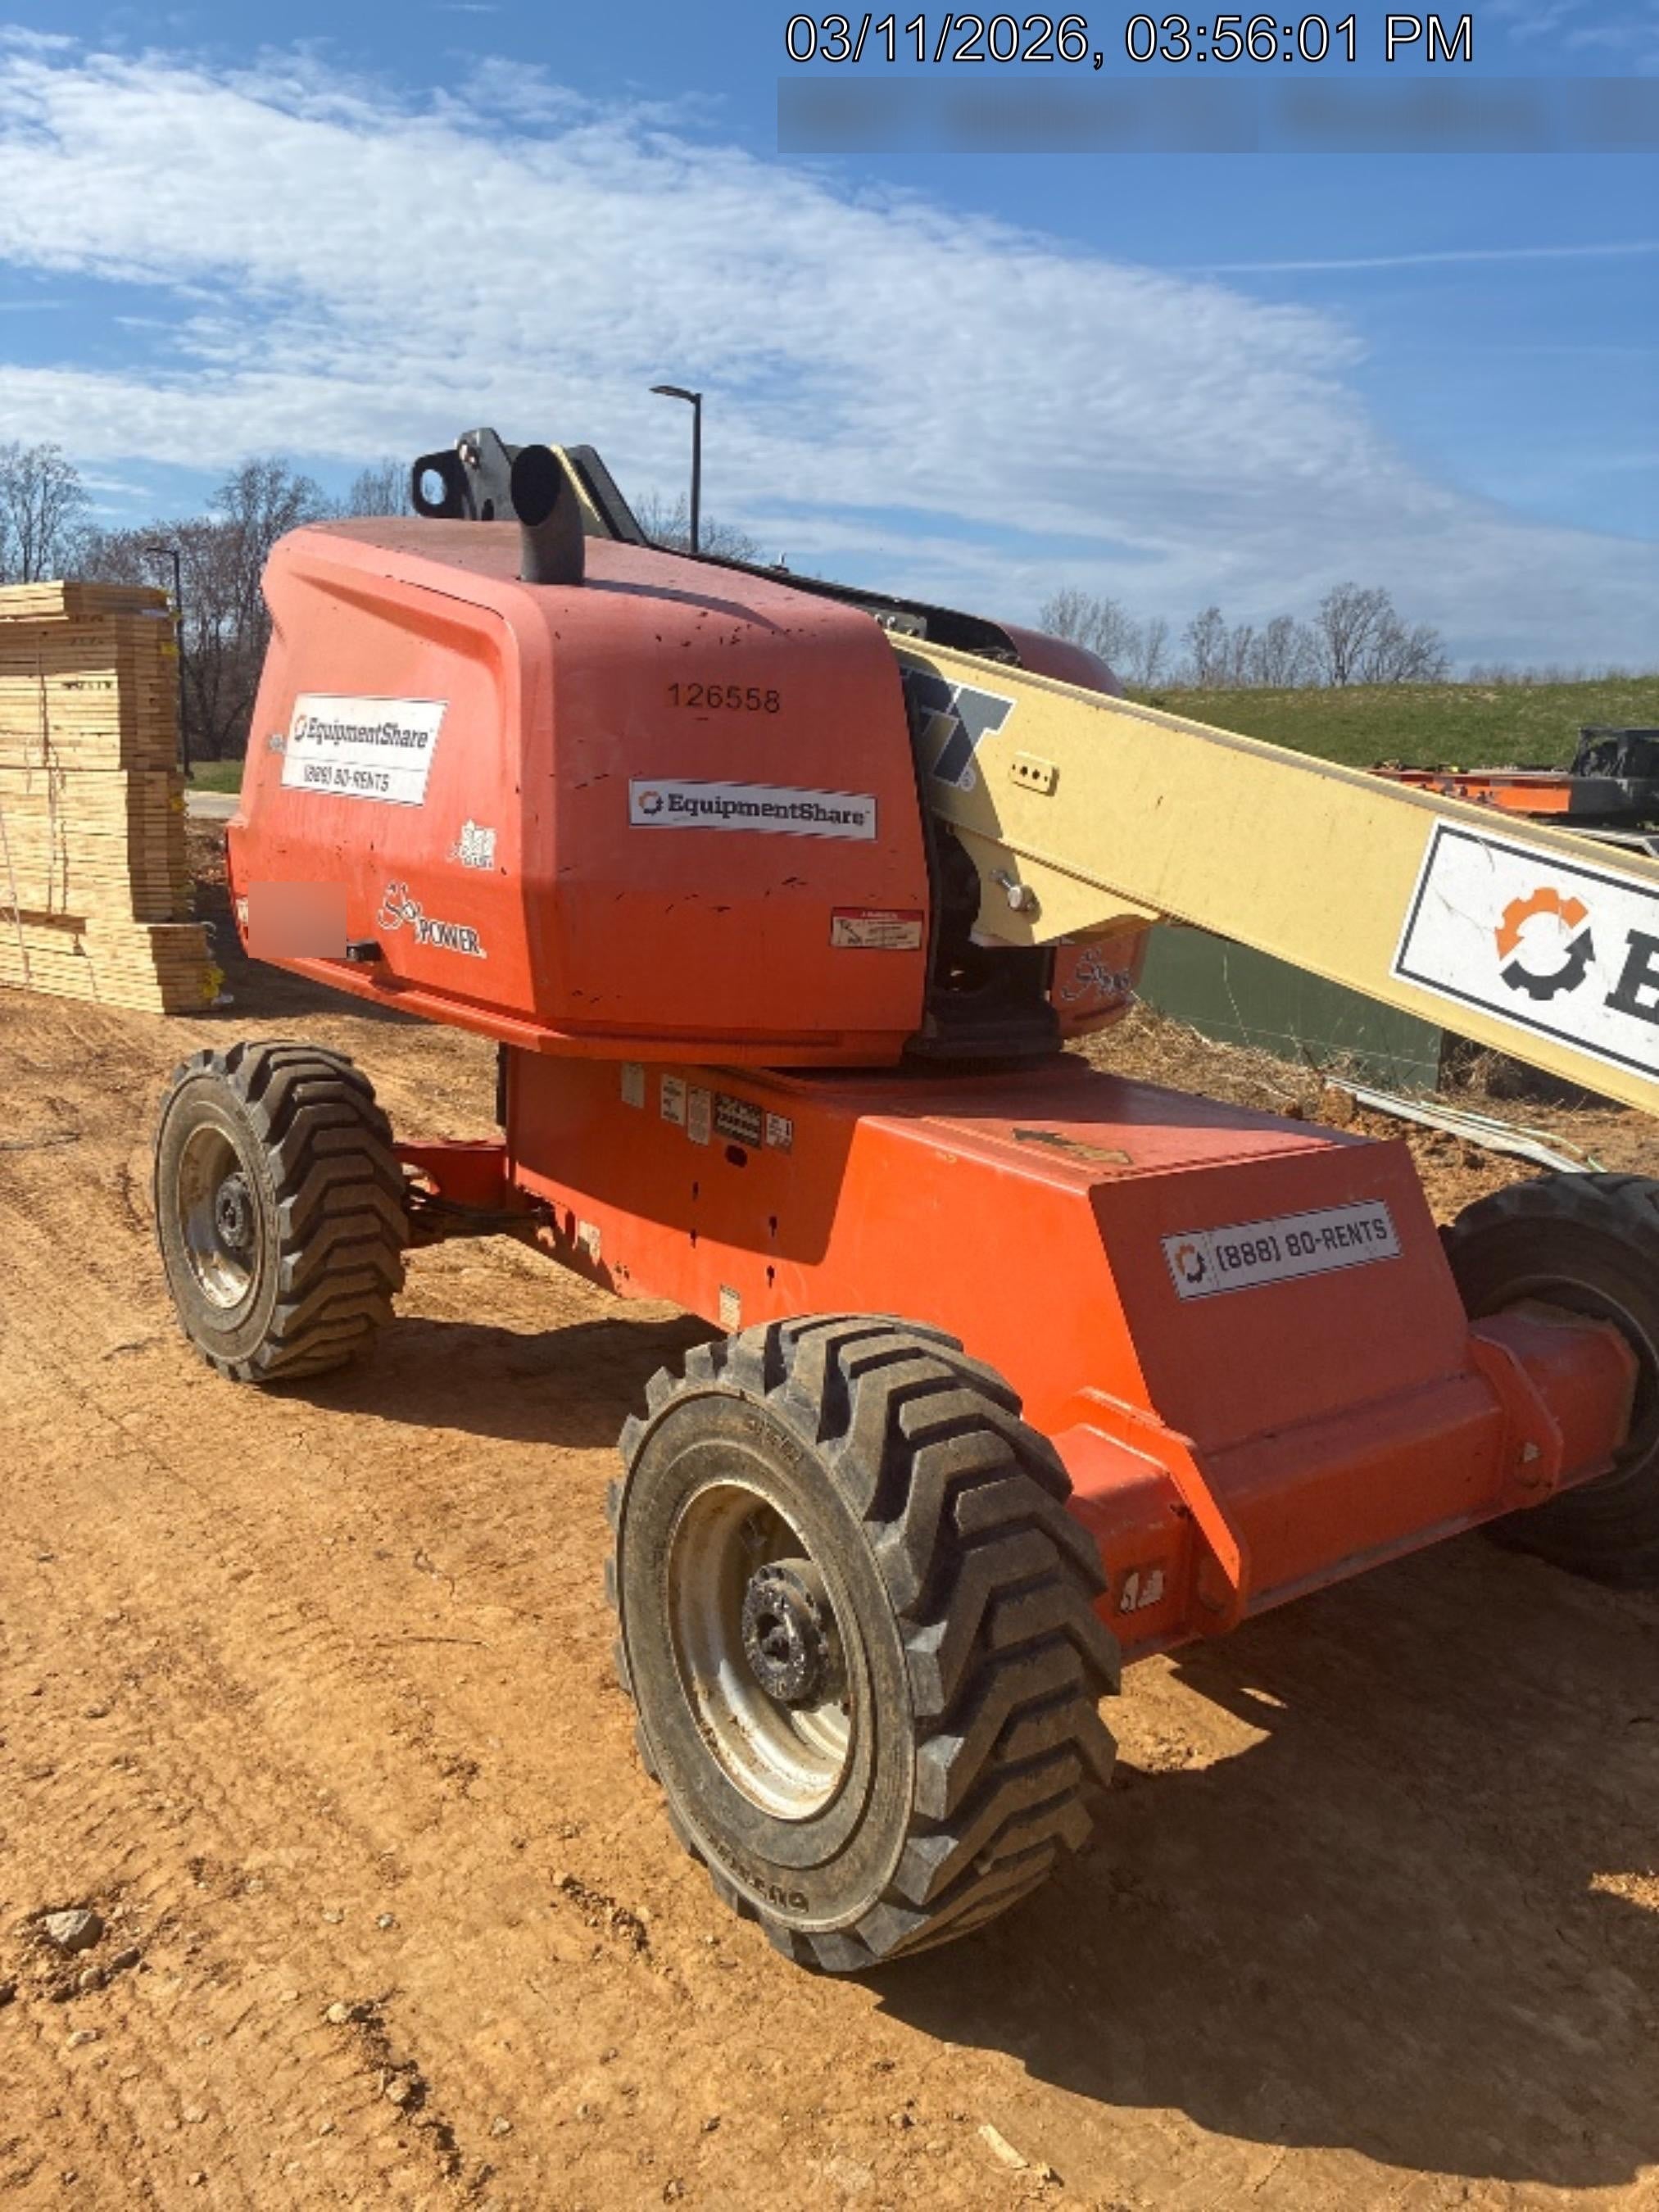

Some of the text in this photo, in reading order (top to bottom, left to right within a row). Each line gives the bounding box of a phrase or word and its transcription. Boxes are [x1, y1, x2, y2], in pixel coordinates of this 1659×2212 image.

[667, 682, 781, 714] 126558
[306, 716, 428, 749] EquipmentShare
[667, 792, 867, 827] EquipmentShare
[1285, 1218, 1389, 1258] 80-RENTS
